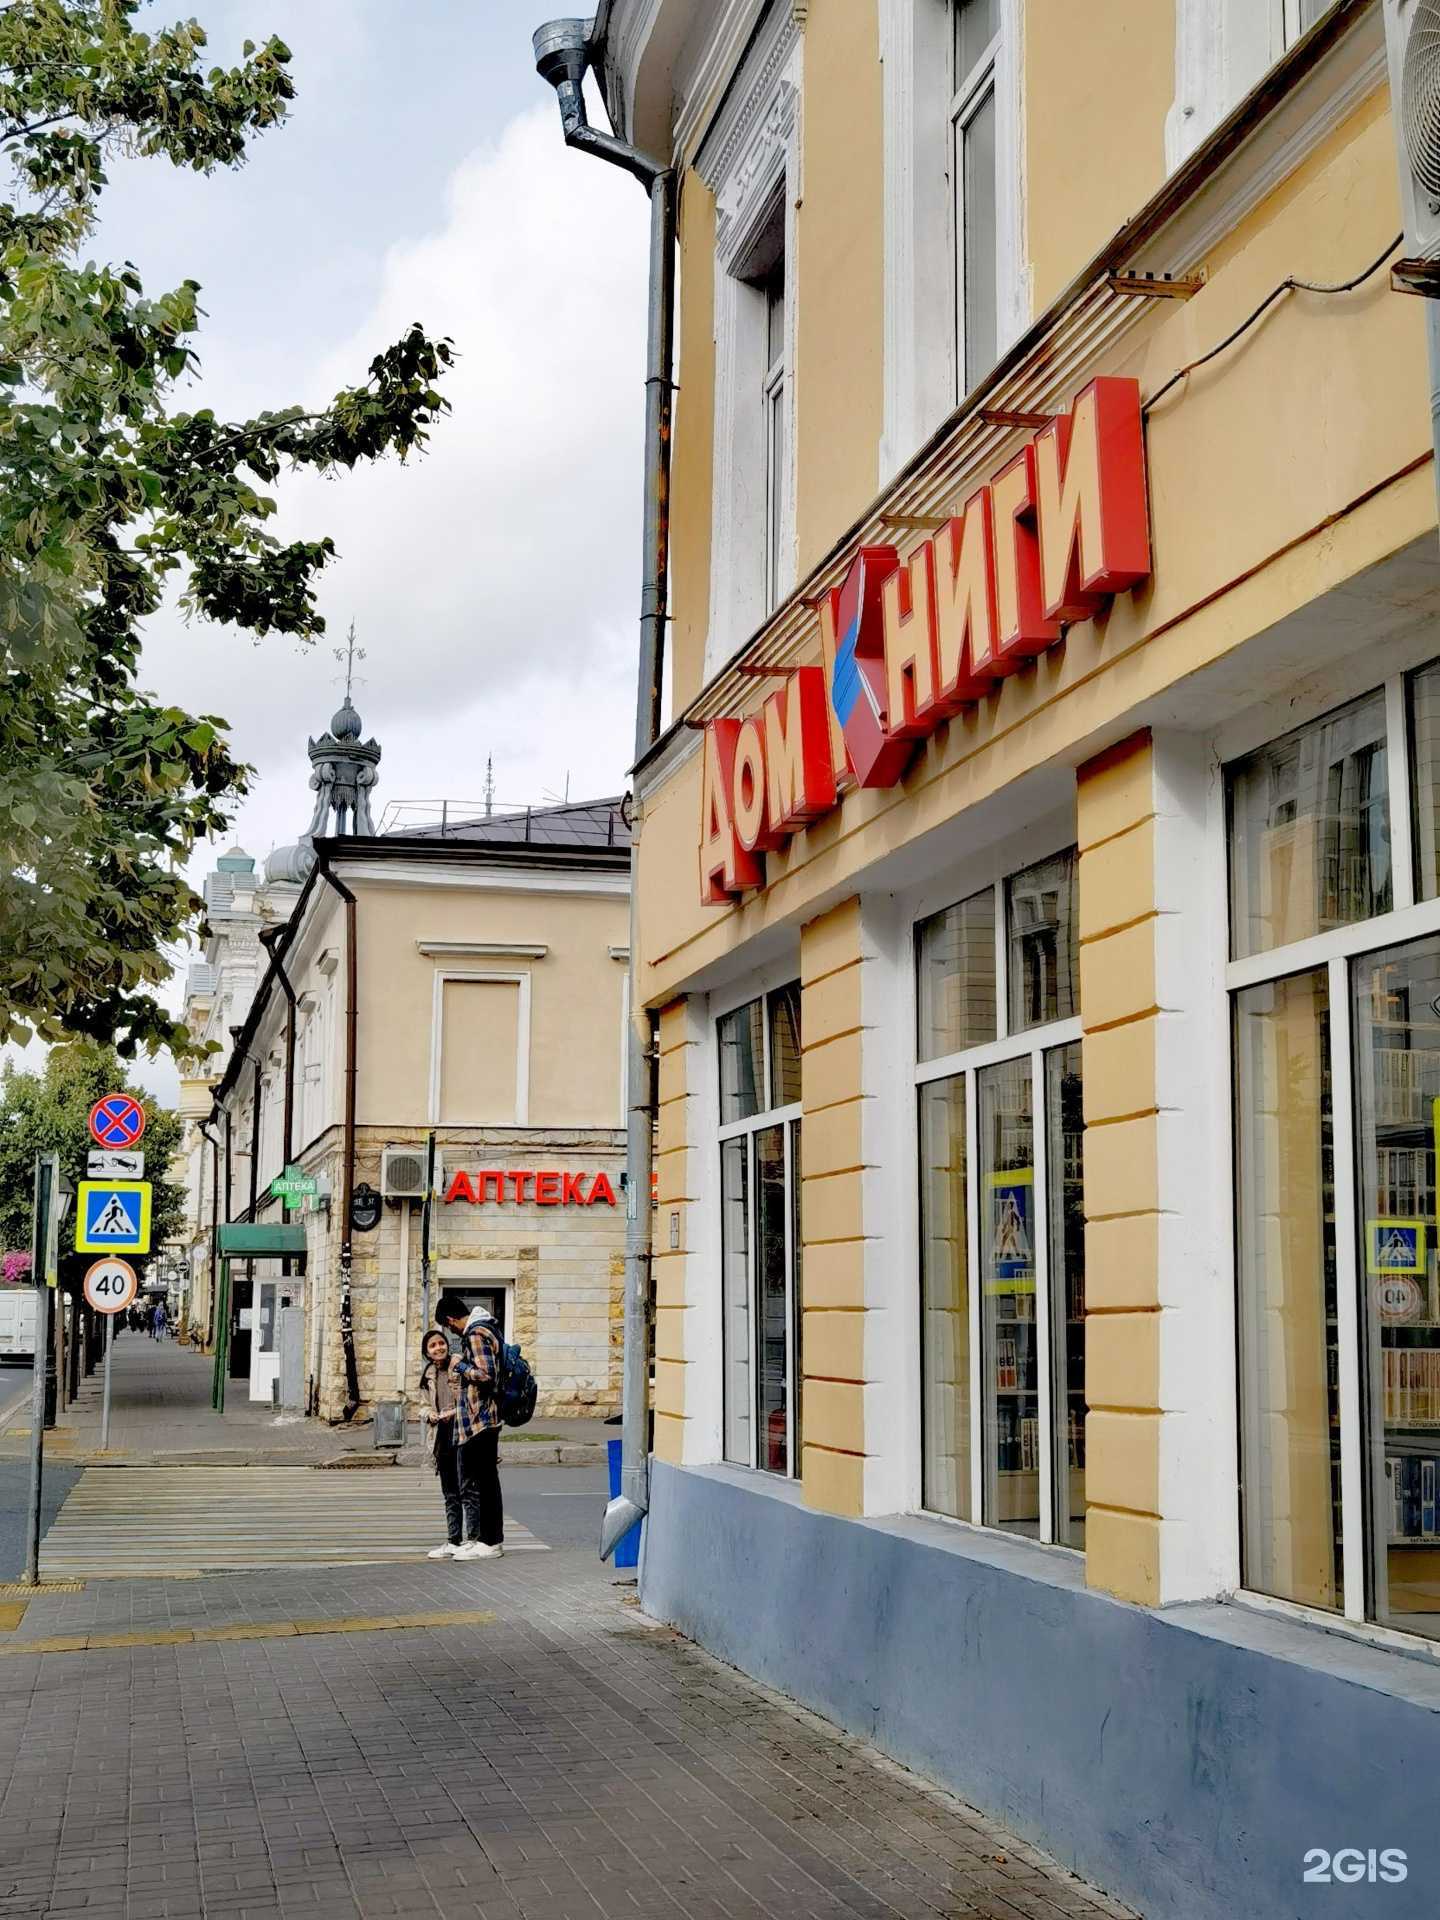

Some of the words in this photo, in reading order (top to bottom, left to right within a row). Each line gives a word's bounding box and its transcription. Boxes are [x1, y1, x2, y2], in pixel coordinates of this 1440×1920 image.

[699, 666, 837, 906] ДОМ
[275, 1181, 314, 1192] АПТЕКА
[444, 1169, 617, 1207] АПТЕКА
[95, 1275, 125, 1295] 40
